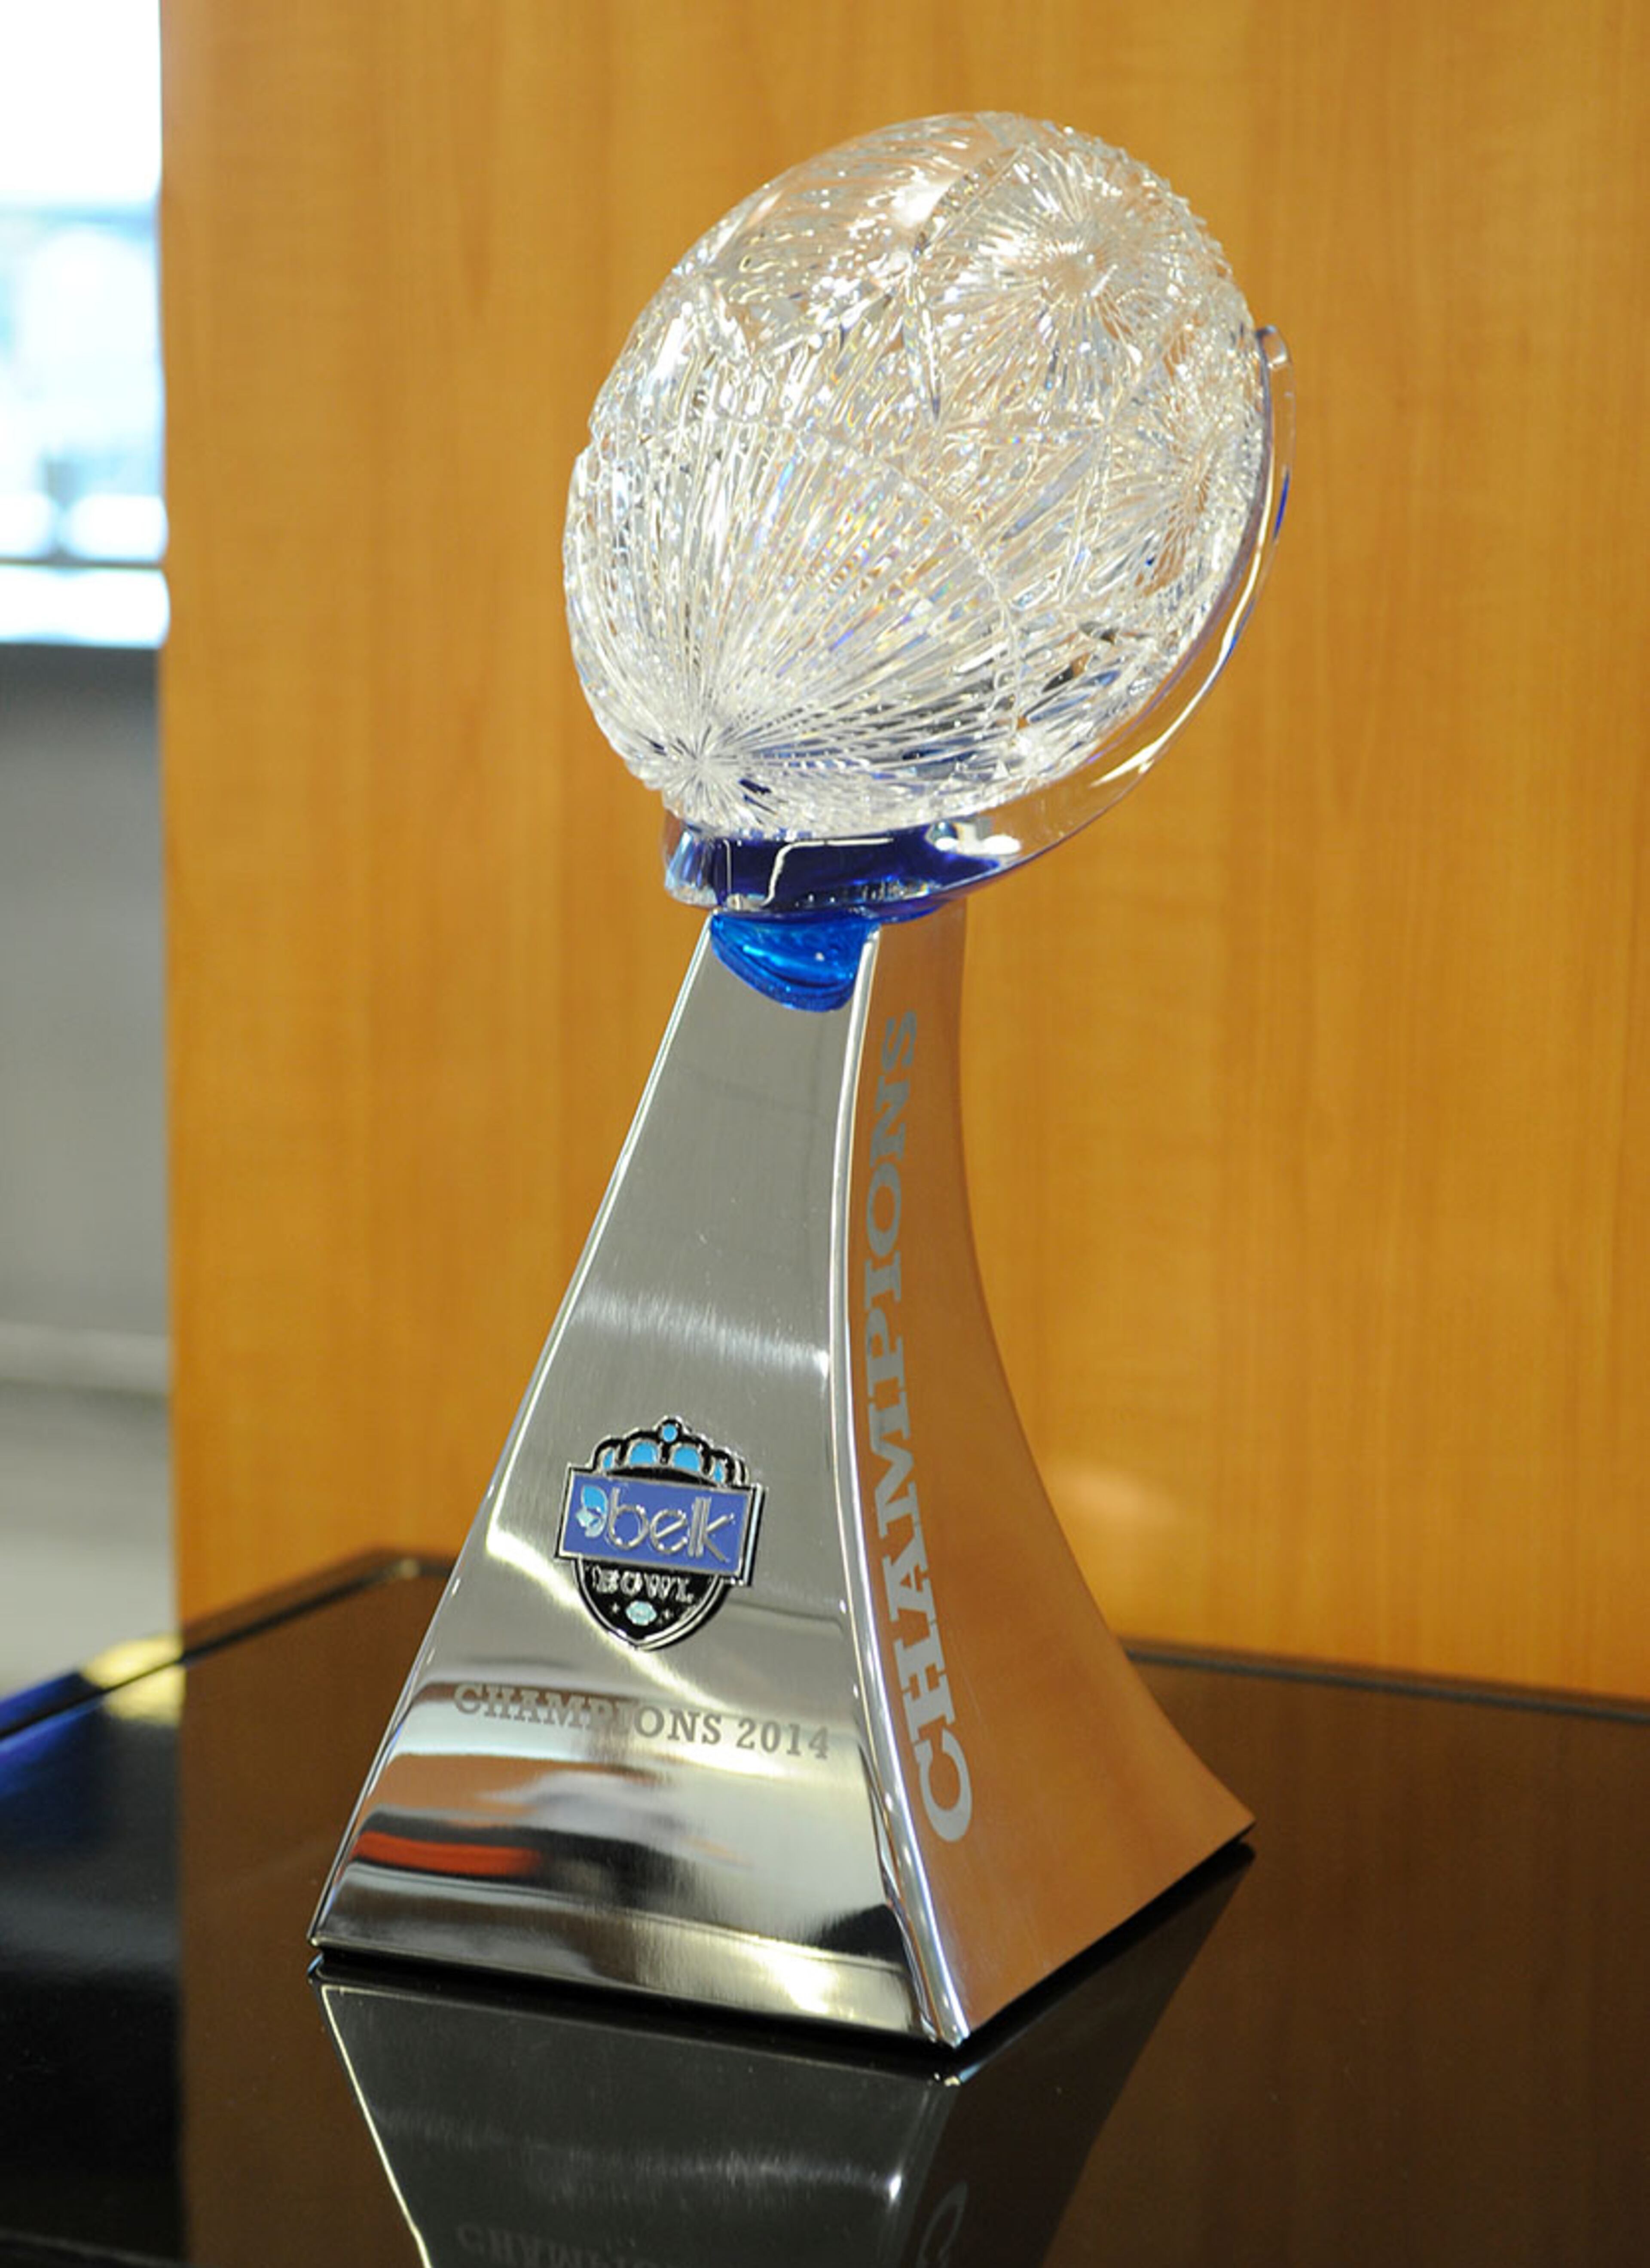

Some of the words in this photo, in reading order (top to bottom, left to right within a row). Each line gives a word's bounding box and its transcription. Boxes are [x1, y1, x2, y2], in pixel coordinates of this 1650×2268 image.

[864, 1010, 972, 1842] CHAMPIONS
[608, 1487, 734, 1563] belk
[592, 1566, 694, 1603] BOWL
[454, 1683, 721, 1745] CHAMPIONS
[736, 1718, 828, 1759] 2014
